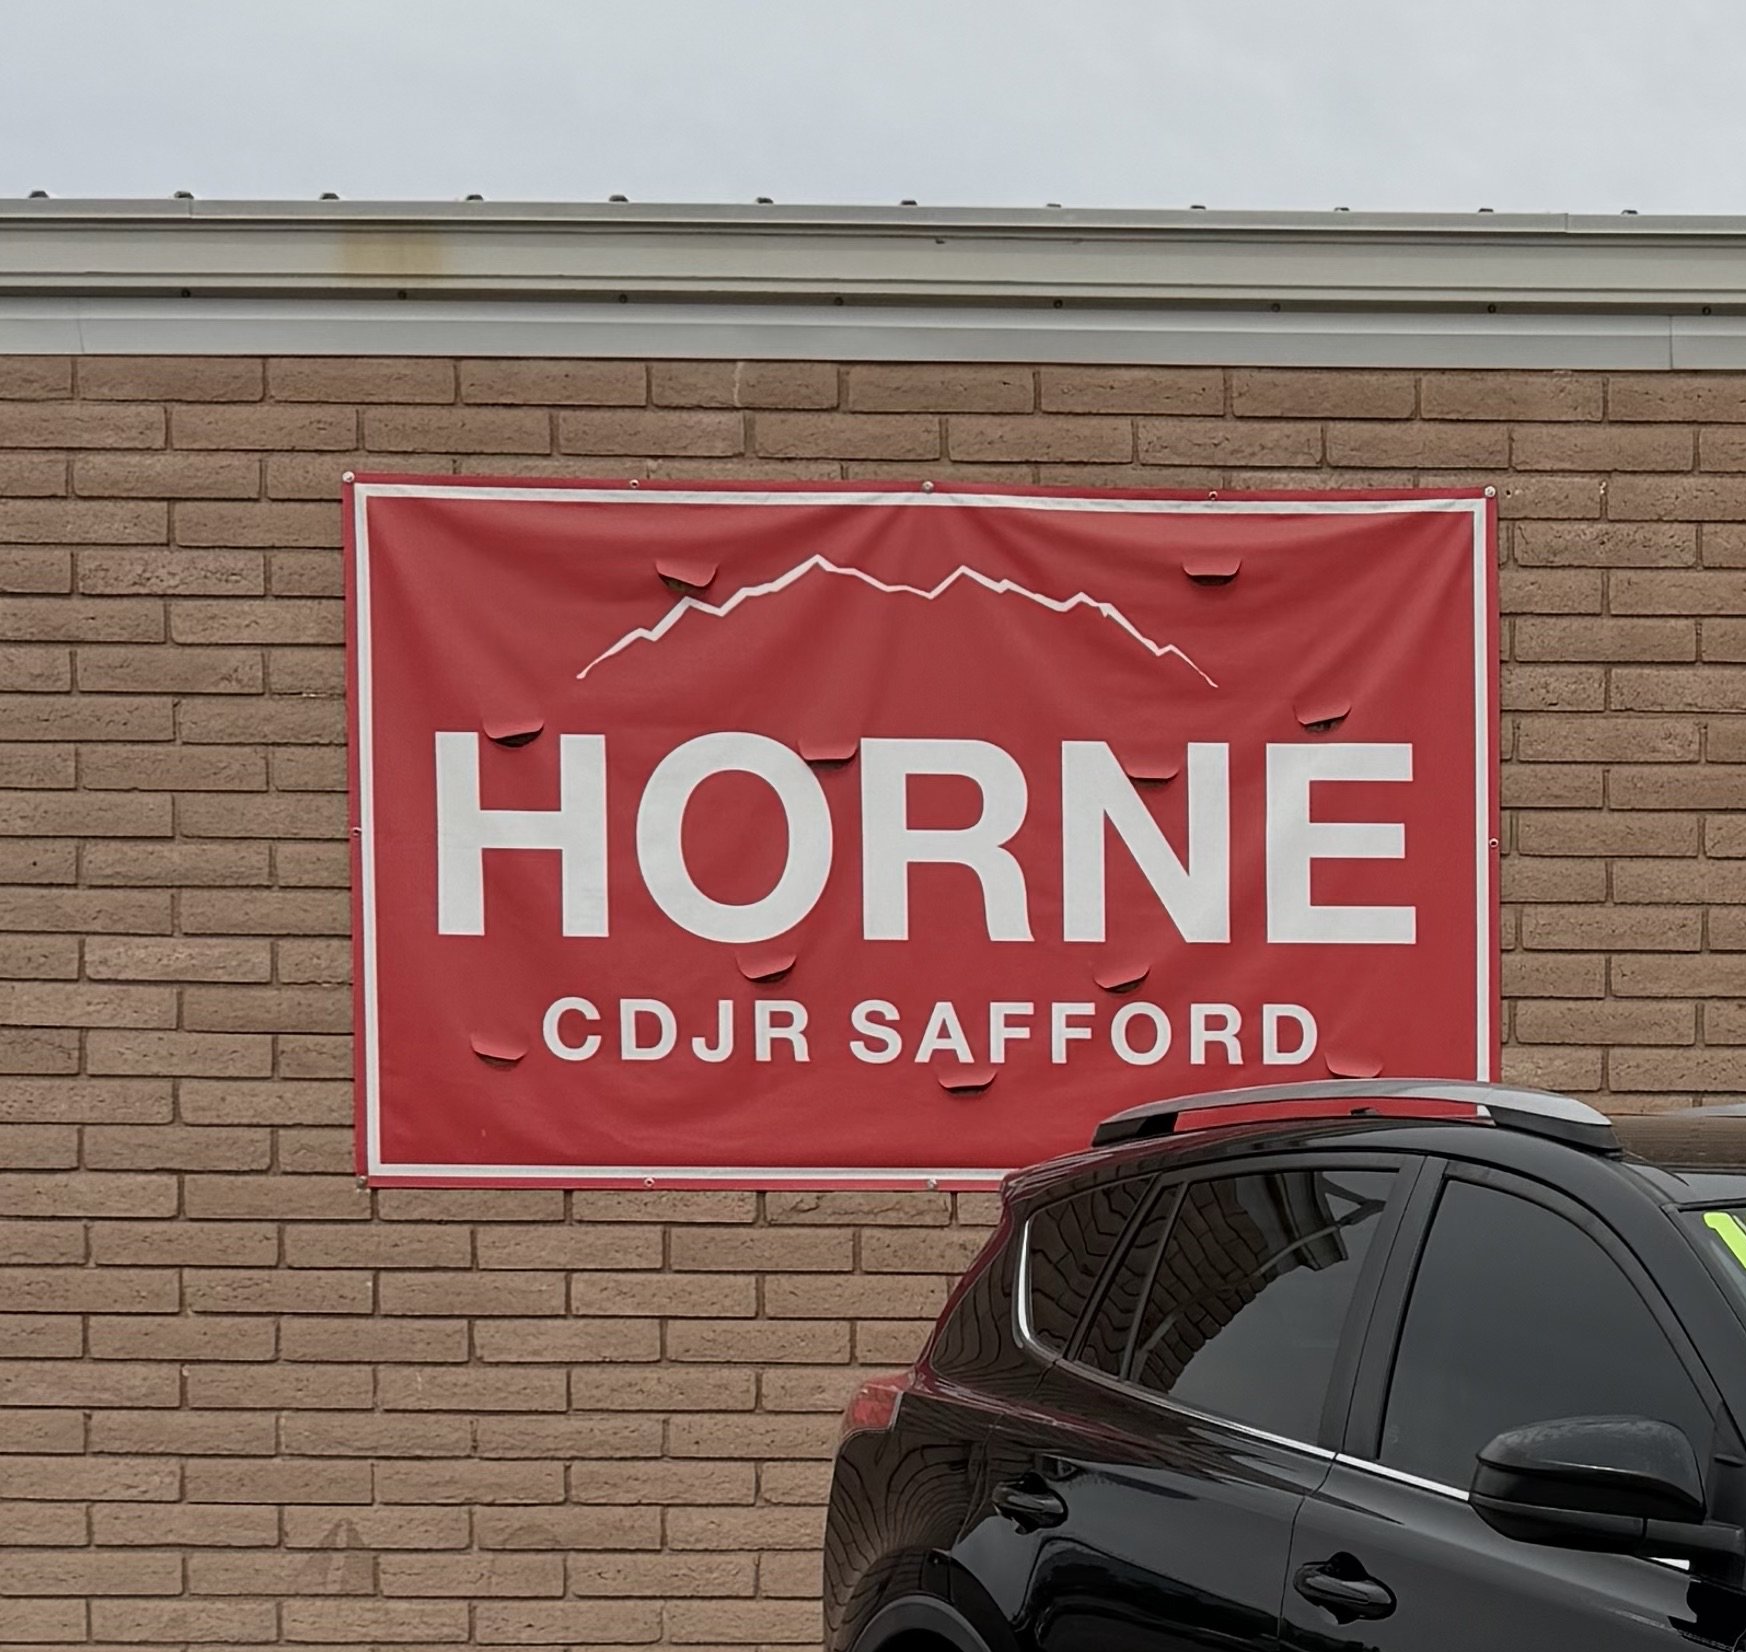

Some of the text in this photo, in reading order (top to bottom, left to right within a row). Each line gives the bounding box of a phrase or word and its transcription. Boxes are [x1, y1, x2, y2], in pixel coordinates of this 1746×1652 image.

[435, 731, 1417, 945] HORNE
[542, 996, 1319, 1066] CDJR SAFFORD
